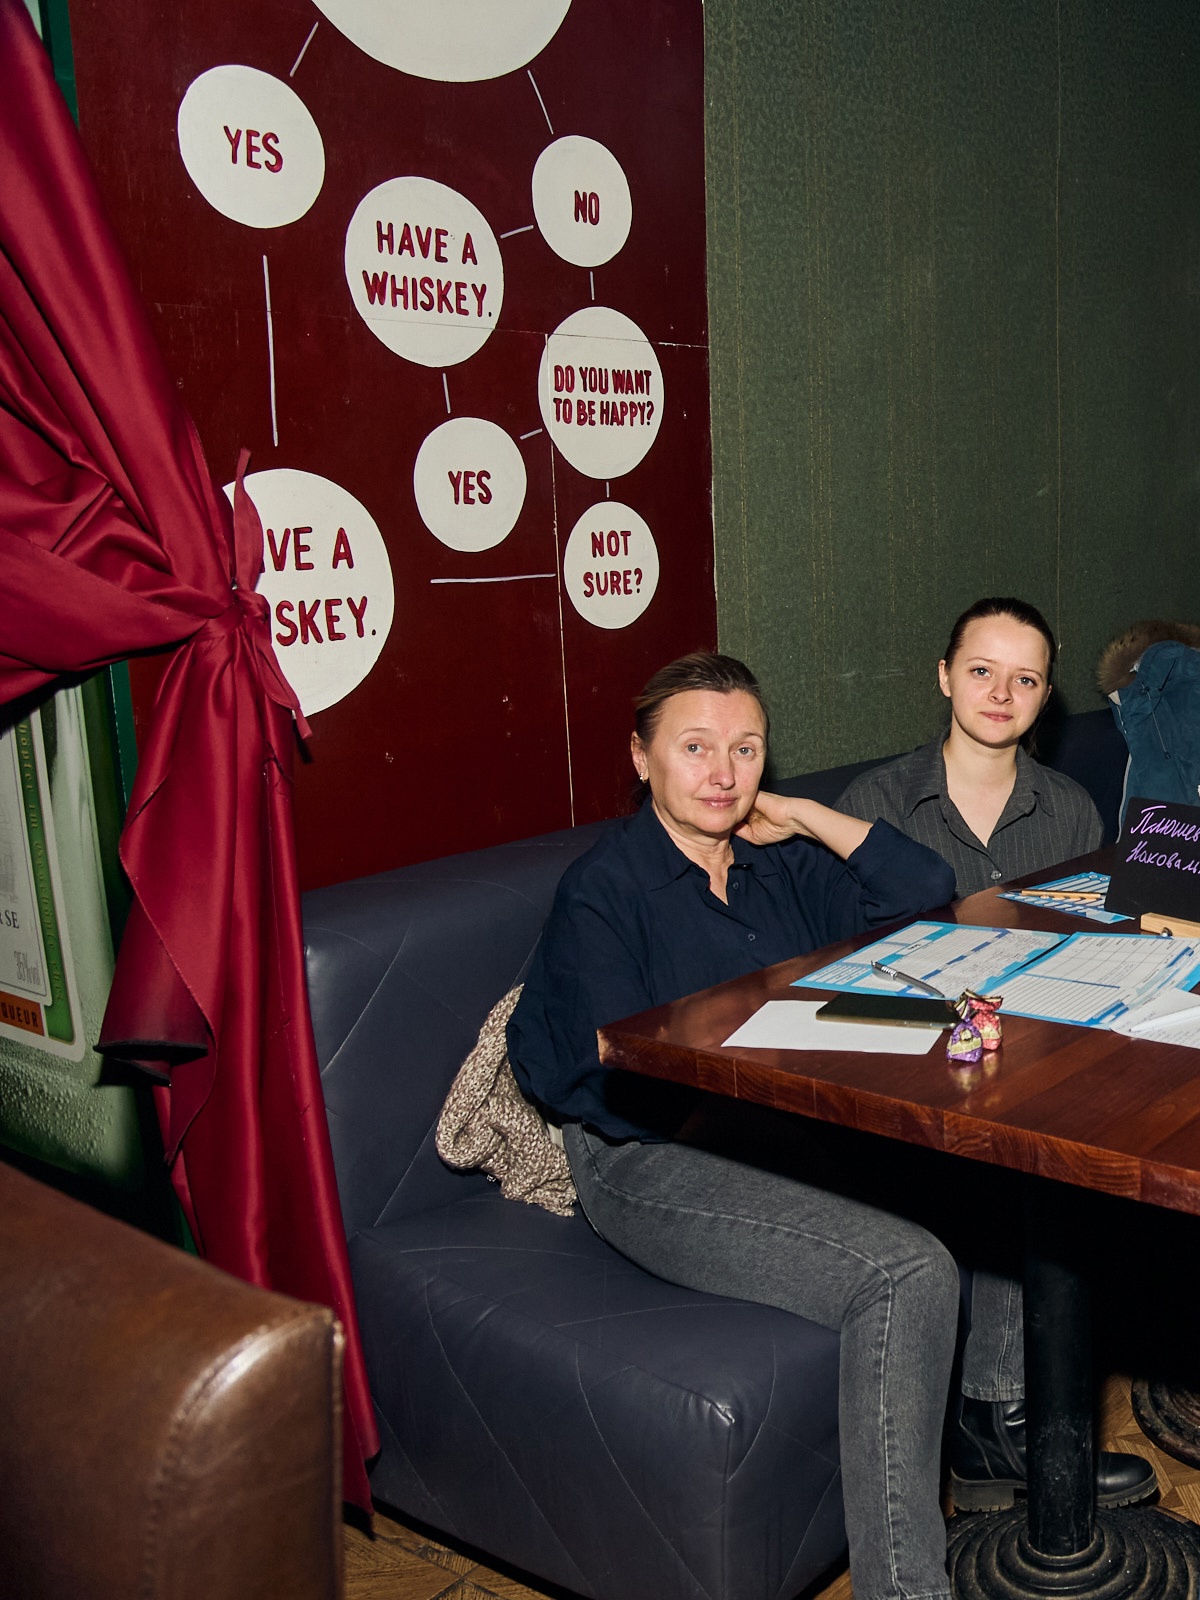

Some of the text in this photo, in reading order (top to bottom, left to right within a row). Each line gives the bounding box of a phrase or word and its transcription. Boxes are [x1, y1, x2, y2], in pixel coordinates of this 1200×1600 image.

[223, 125, 284, 174] YES
[574, 190, 600, 225] NO
[376, 220, 478, 265] HAVE A
[362, 270, 493, 318] WHISKEY.
[554, 365, 652, 395] DO YOU WANT
[553, 398, 655, 426] TO BE HAPPY?
[448, 470, 492, 505] YES
[263, 526, 354, 572] VE A
[591, 530, 632, 558] NOT
[583, 568, 643, 598] SURE?
[275, 595, 377, 647] SKEY.
[1, 1001, 39, 1028] QUEUR
